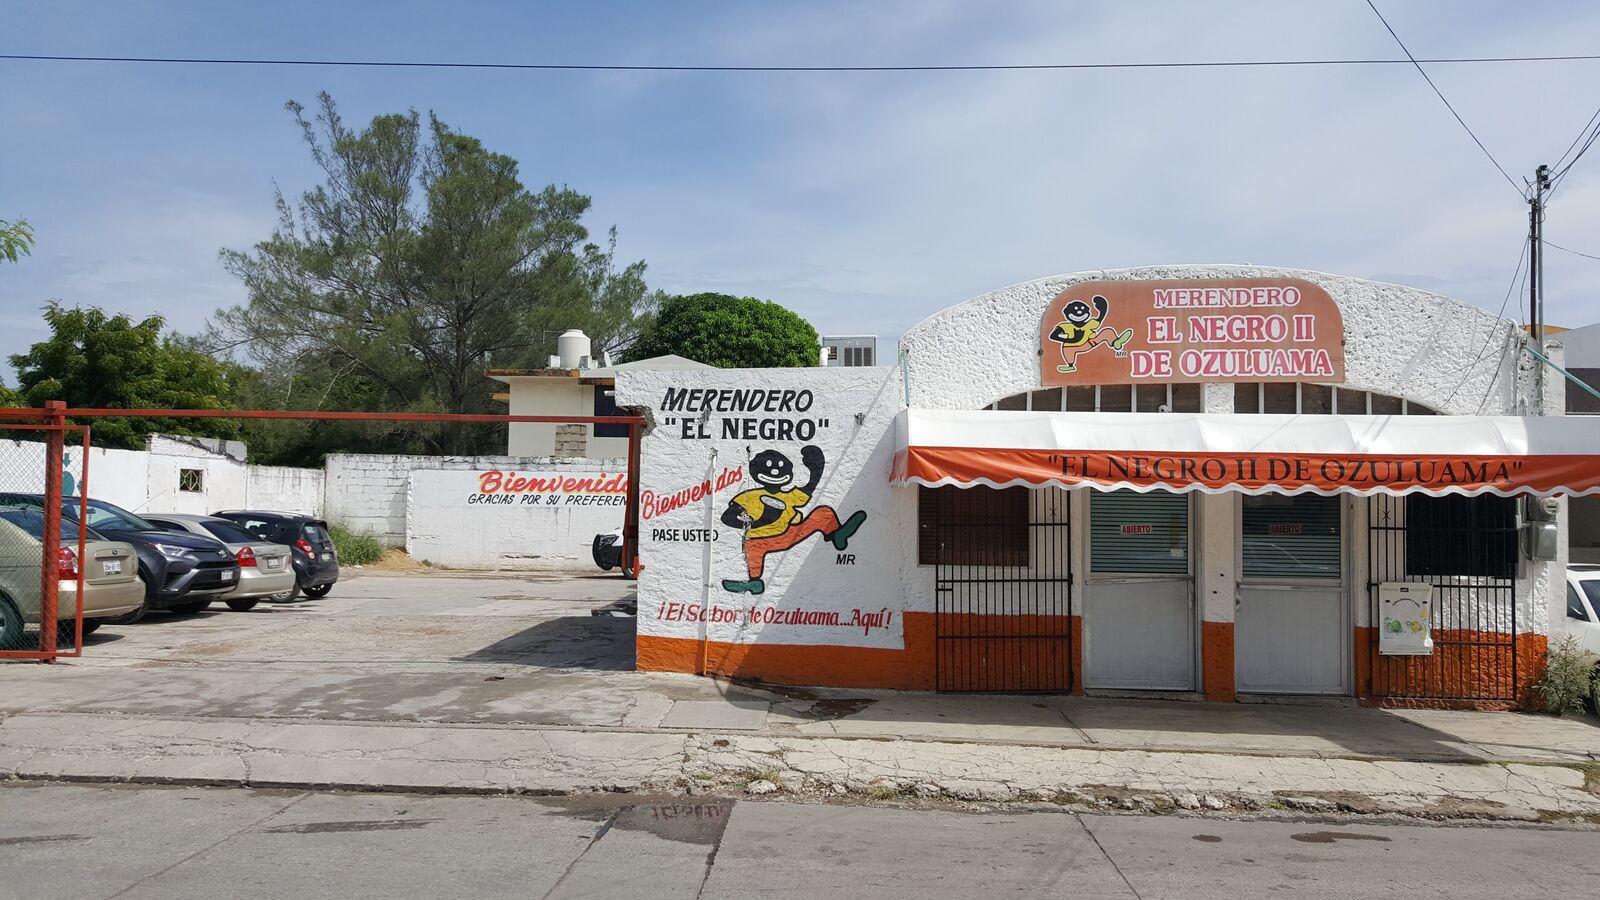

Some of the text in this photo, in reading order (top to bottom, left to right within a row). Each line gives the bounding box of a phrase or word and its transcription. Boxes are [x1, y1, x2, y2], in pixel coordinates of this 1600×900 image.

[1153, 286, 1301, 309] MERENDERO
[1147, 314, 1316, 343] EL NEGRO II
[1115, 350, 1128, 359] MR
[1131, 349, 1334, 377] DE OZULUAMA
[660, 387, 814, 413] MERENDERO
[665, 416, 829, 441] "EL NEGRO"
[1048, 454, 1522, 484] "EL NEGRO II DE OZULUAMA"
[468, 494, 515, 505] GRACIAS
[520, 494, 541, 505] POR
[546, 494, 560, 506] SU
[641, 465, 743, 520] Bienvendos
[652, 529, 719, 541] PASE USTED
[1122, 525, 1151, 534] ABIERTO
[836, 554, 856, 565] MR
